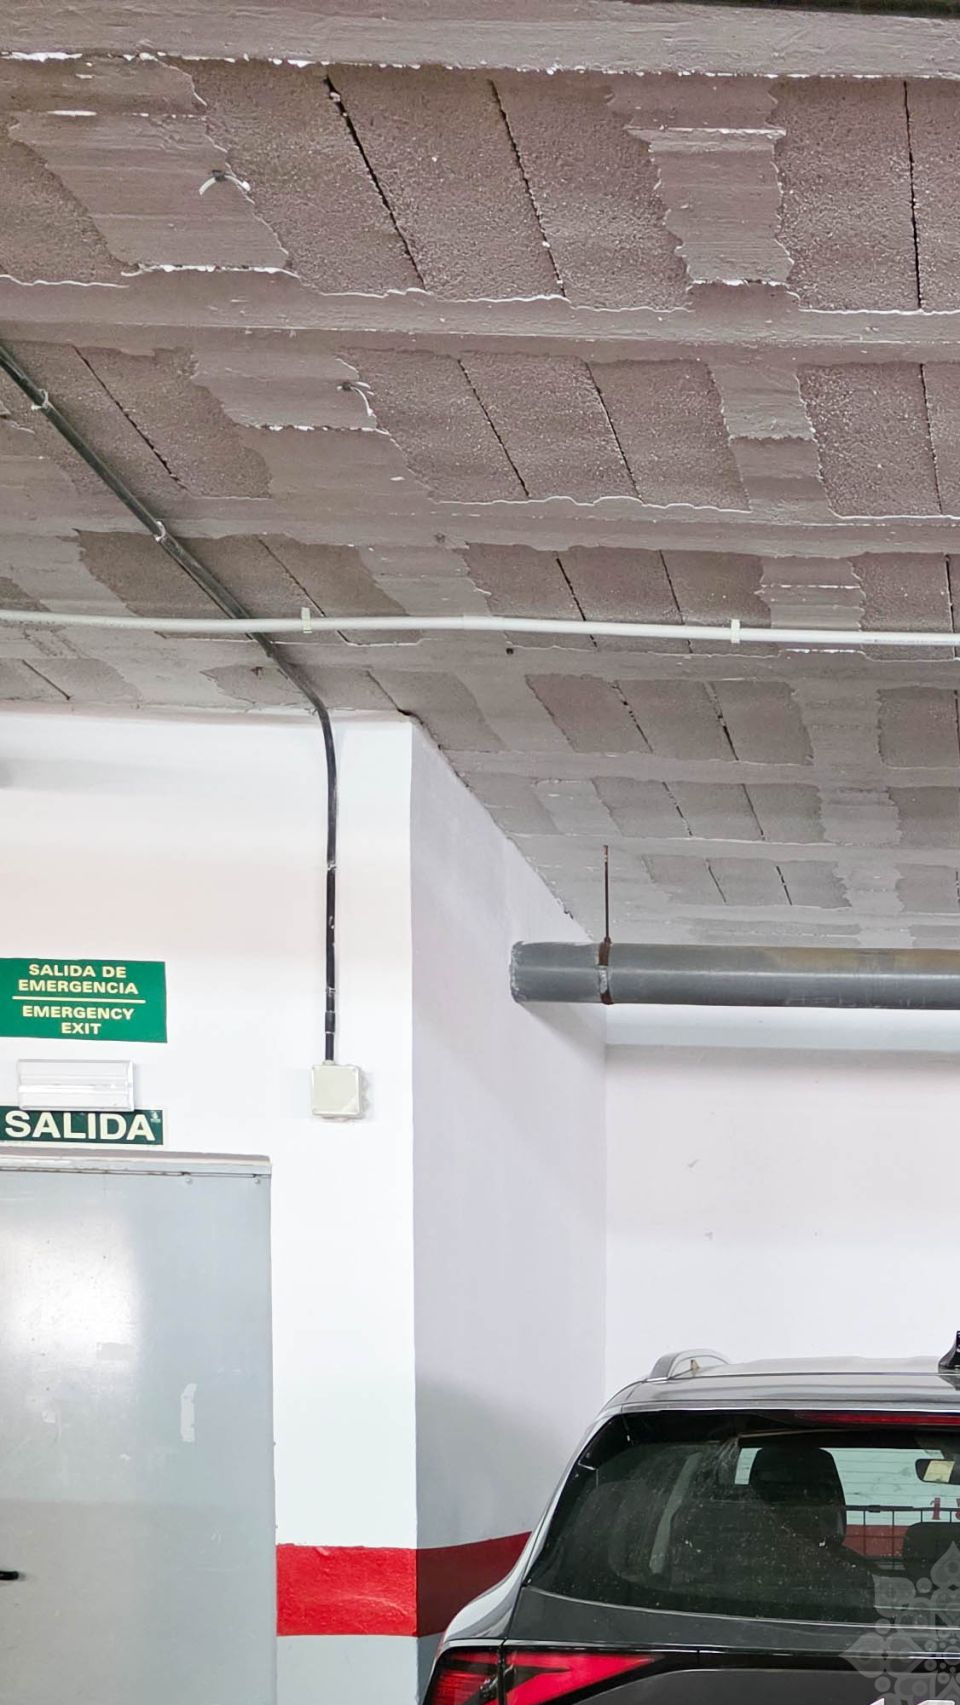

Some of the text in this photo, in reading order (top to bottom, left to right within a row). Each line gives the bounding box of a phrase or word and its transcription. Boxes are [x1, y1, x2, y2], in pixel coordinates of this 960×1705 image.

[28, 964, 127, 979] SALIDA DE
[18, 979, 139, 995] EMERGENCIA
[22, 1005, 134, 1020] EMERGENCY
[61, 1022, 102, 1035] EXIT
[5, 1111, 155, 1141] SALIDA
